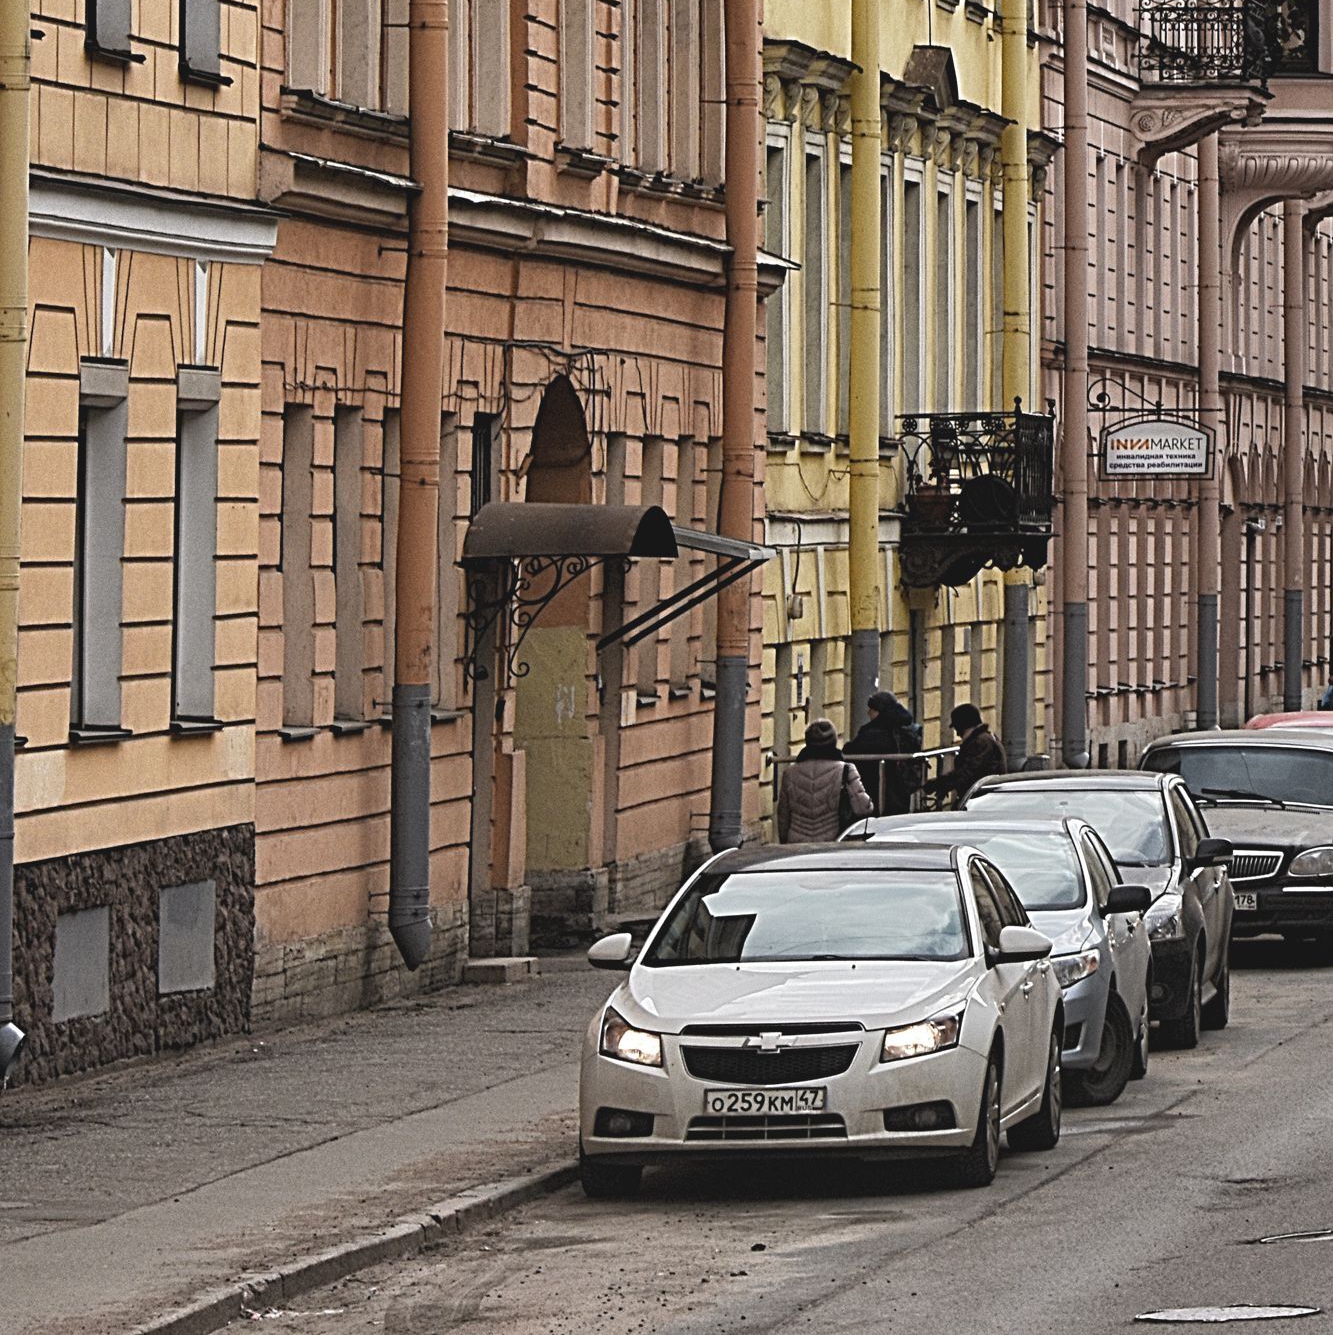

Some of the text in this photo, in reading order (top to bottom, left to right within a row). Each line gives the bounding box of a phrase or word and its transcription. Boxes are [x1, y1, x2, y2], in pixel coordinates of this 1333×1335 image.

[1116, 453, 1164, 461] инвалидная
[1109, 461, 1203, 470] средства реабилитации
[799, 1089, 819, 1106] 47
